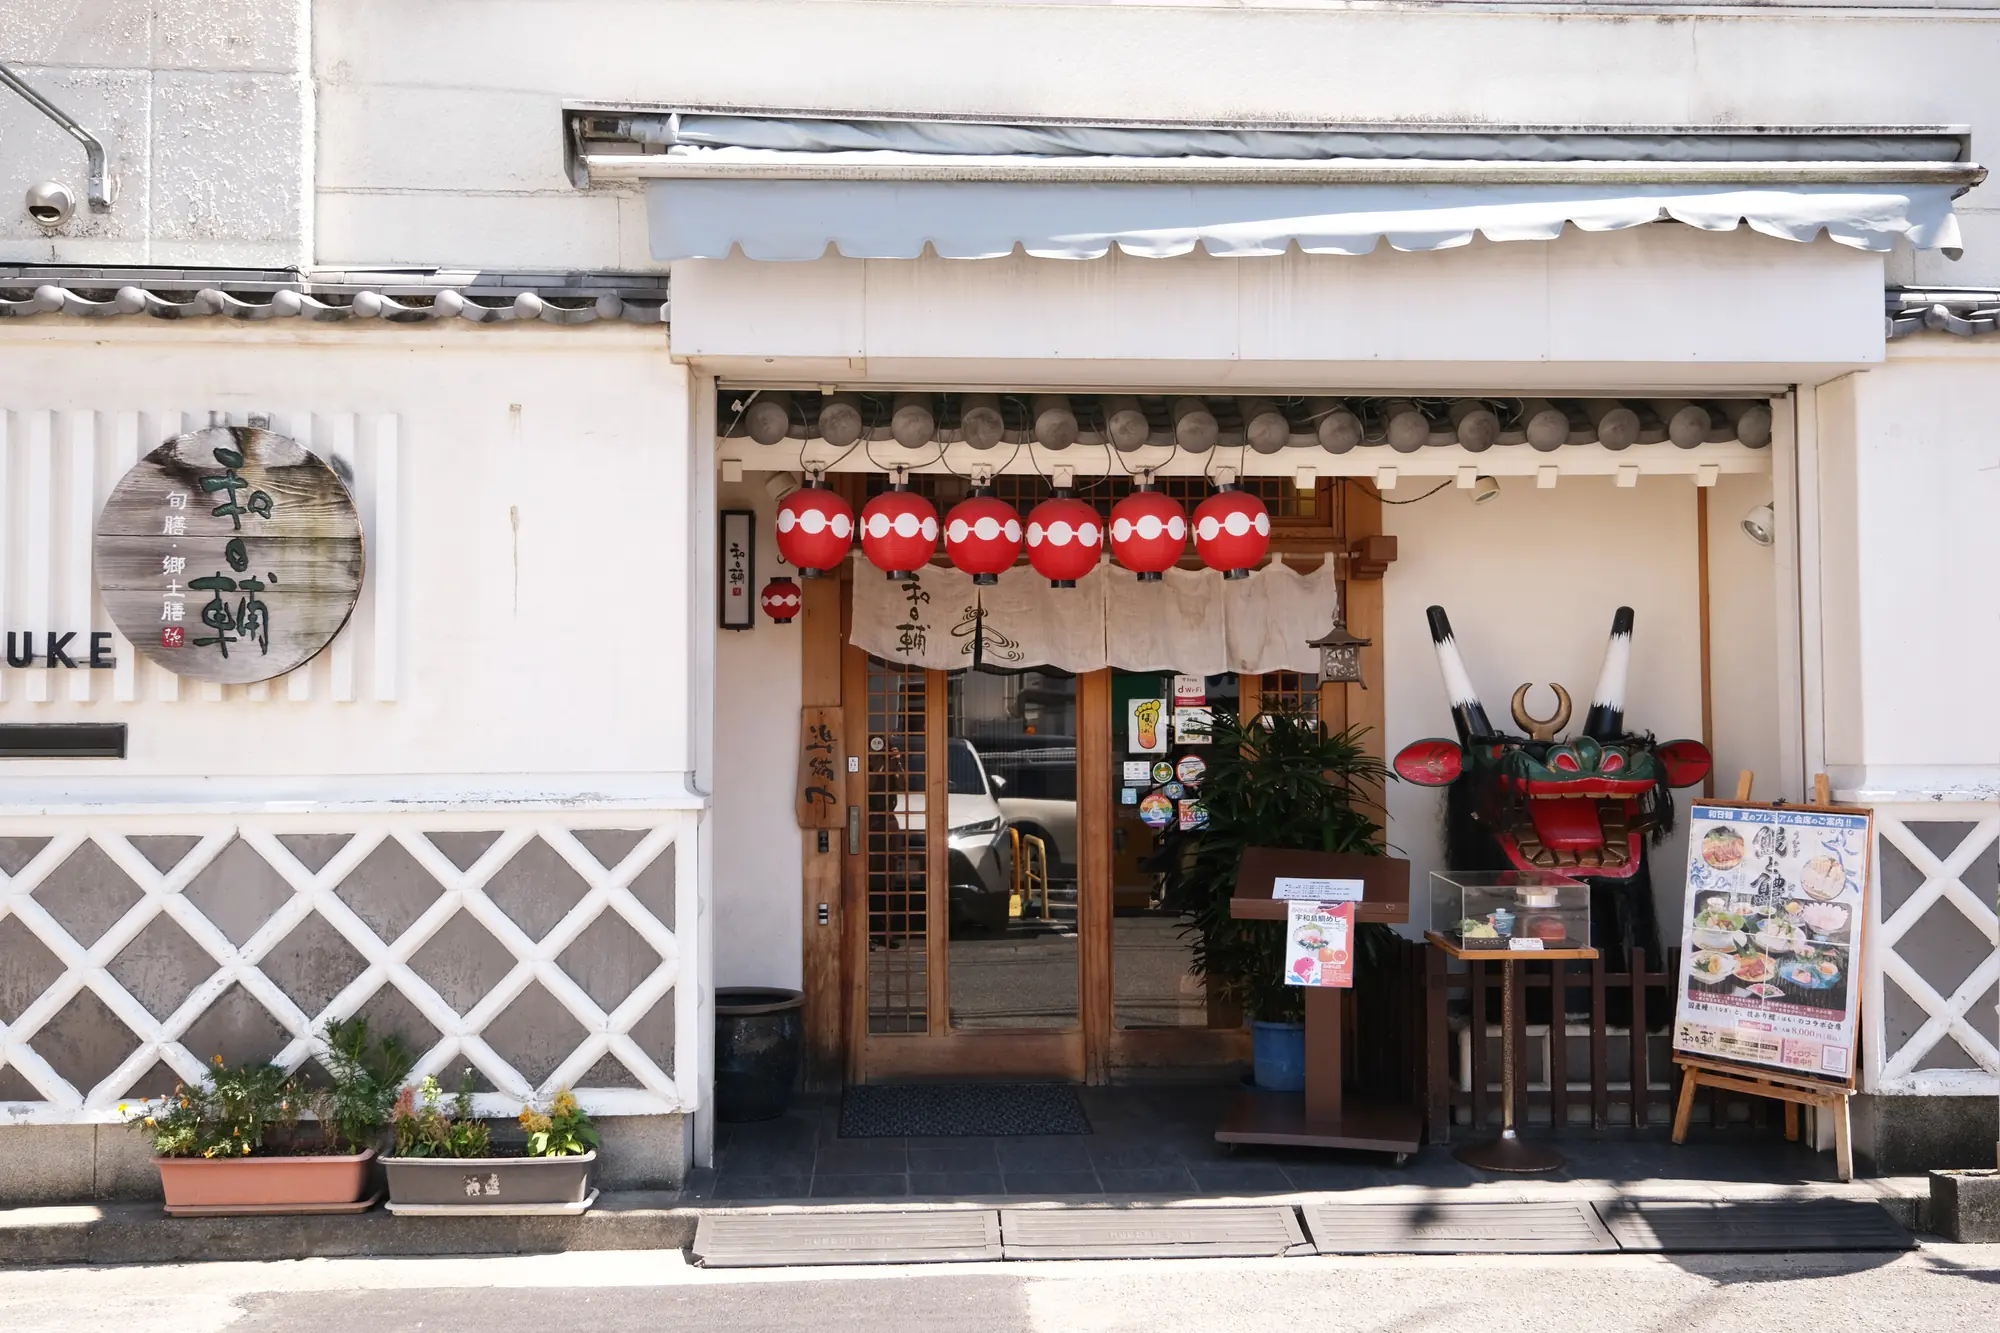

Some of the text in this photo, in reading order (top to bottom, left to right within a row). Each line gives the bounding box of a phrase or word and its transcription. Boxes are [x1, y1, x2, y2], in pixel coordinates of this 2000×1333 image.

[161, 490, 188, 622] 旬膳・郷土膳
[188, 447, 278, 658] 和日輔
[729, 542, 745, 585] 和日輔
[7, 631, 113, 668] UKE
[1294, 913, 1341, 923] 宇和島鯛めし
